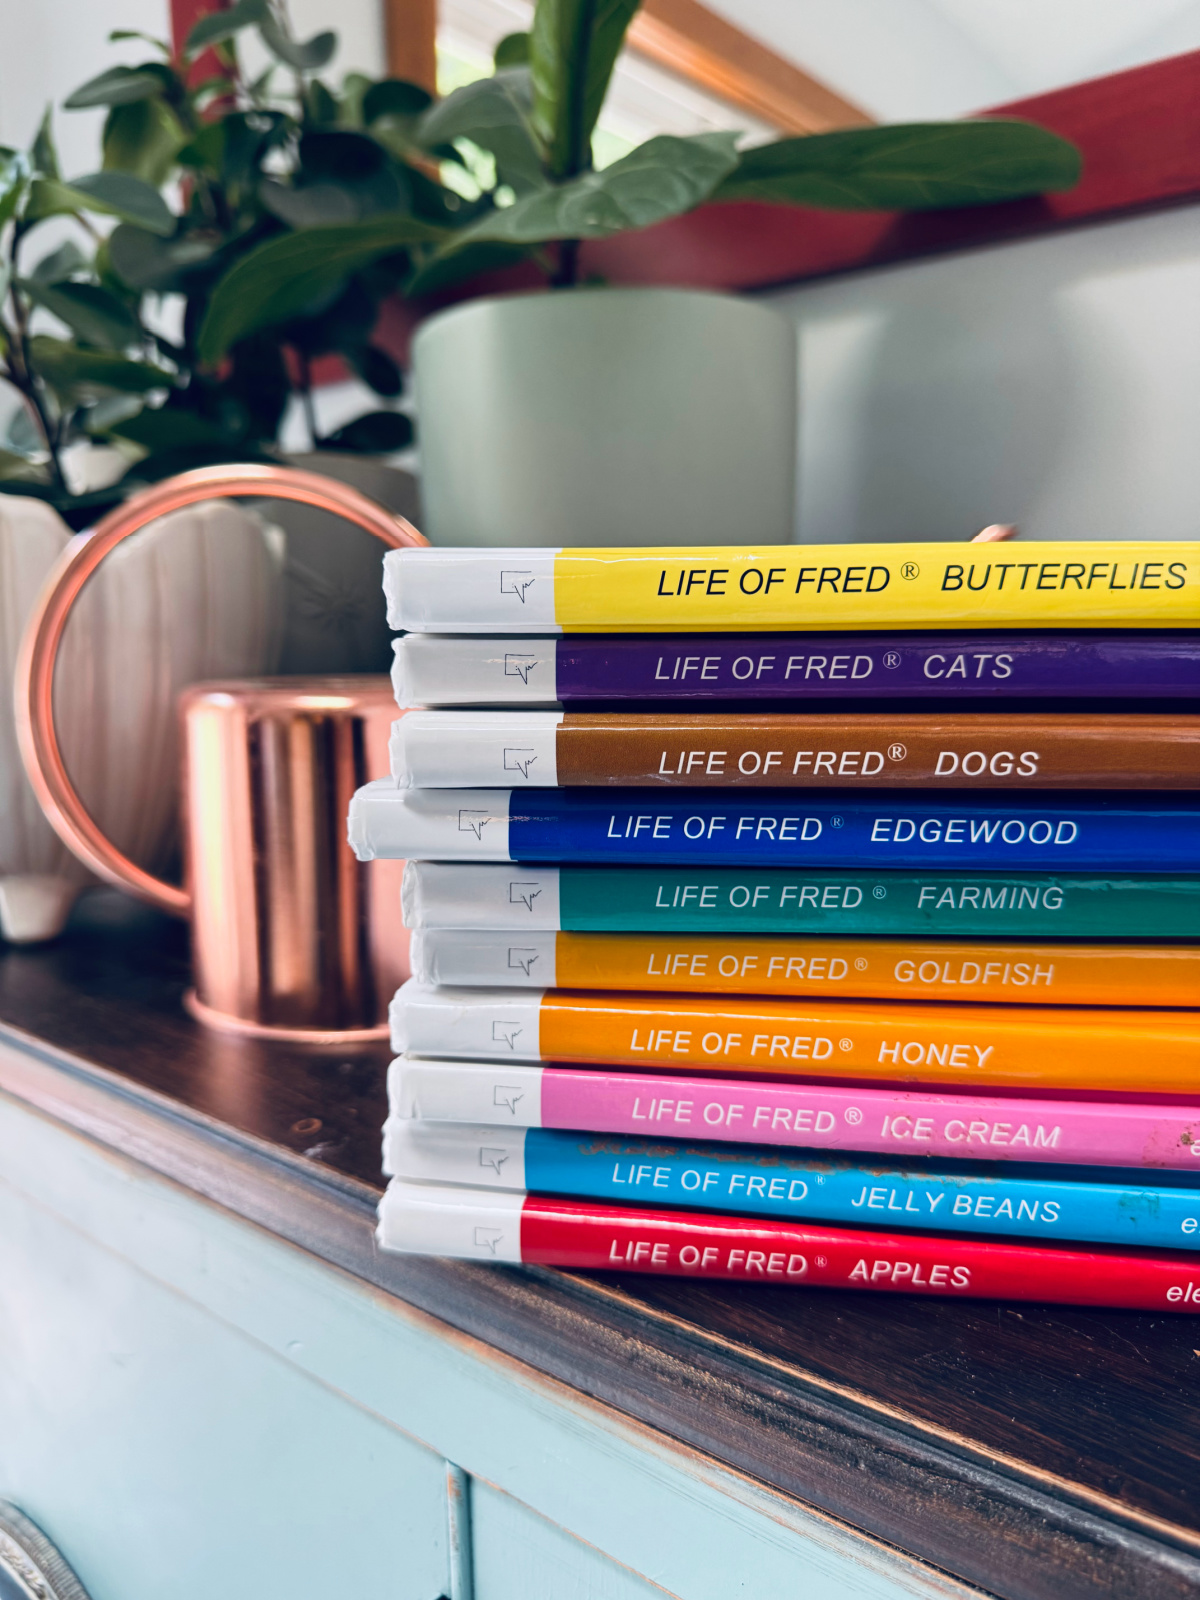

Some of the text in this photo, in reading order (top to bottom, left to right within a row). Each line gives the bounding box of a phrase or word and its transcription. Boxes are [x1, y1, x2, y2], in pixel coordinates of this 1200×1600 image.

[657, 569, 729, 596] LIFE
[739, 568, 785, 595] OF
[941, 562, 1188, 591] BUTTERFLIES
[655, 657, 721, 680] LIFE
[731, 656, 777, 680] OF
[923, 654, 1014, 680] CATS
[658, 752, 727, 775] LIFE
[738, 751, 783, 775] OF
[934, 751, 1040, 777] DOGS
[607, 816, 673, 839] LIFE
[683, 816, 726, 840] OF
[870, 819, 1078, 845] EDGEWOOD
[655, 886, 720, 908] LIFE
[729, 886, 770, 908] OF
[917, 886, 1064, 911] FARMING
[647, 954, 708, 977] LIFE
[718, 955, 758, 978] OF
[894, 960, 1054, 986] GOLDFISH
[630, 1029, 692, 1054] LIFE
[701, 1032, 743, 1056] OF
[878, 1041, 994, 1068] HONEY
[632, 1098, 694, 1122] LIFE
[703, 1101, 744, 1126] OF
[881, 1115, 933, 1141] ICE
[944, 1119, 1061, 1149] CREAM
[612, 1163, 671, 1189] LIFE
[680, 1169, 720, 1193] OF
[851, 1186, 944, 1213] JELLY
[953, 1195, 1061, 1223] BEANS
[609, 1240, 670, 1265] LIFE
[679, 1244, 720, 1269] OF
[849, 1258, 971, 1288] APPLES
